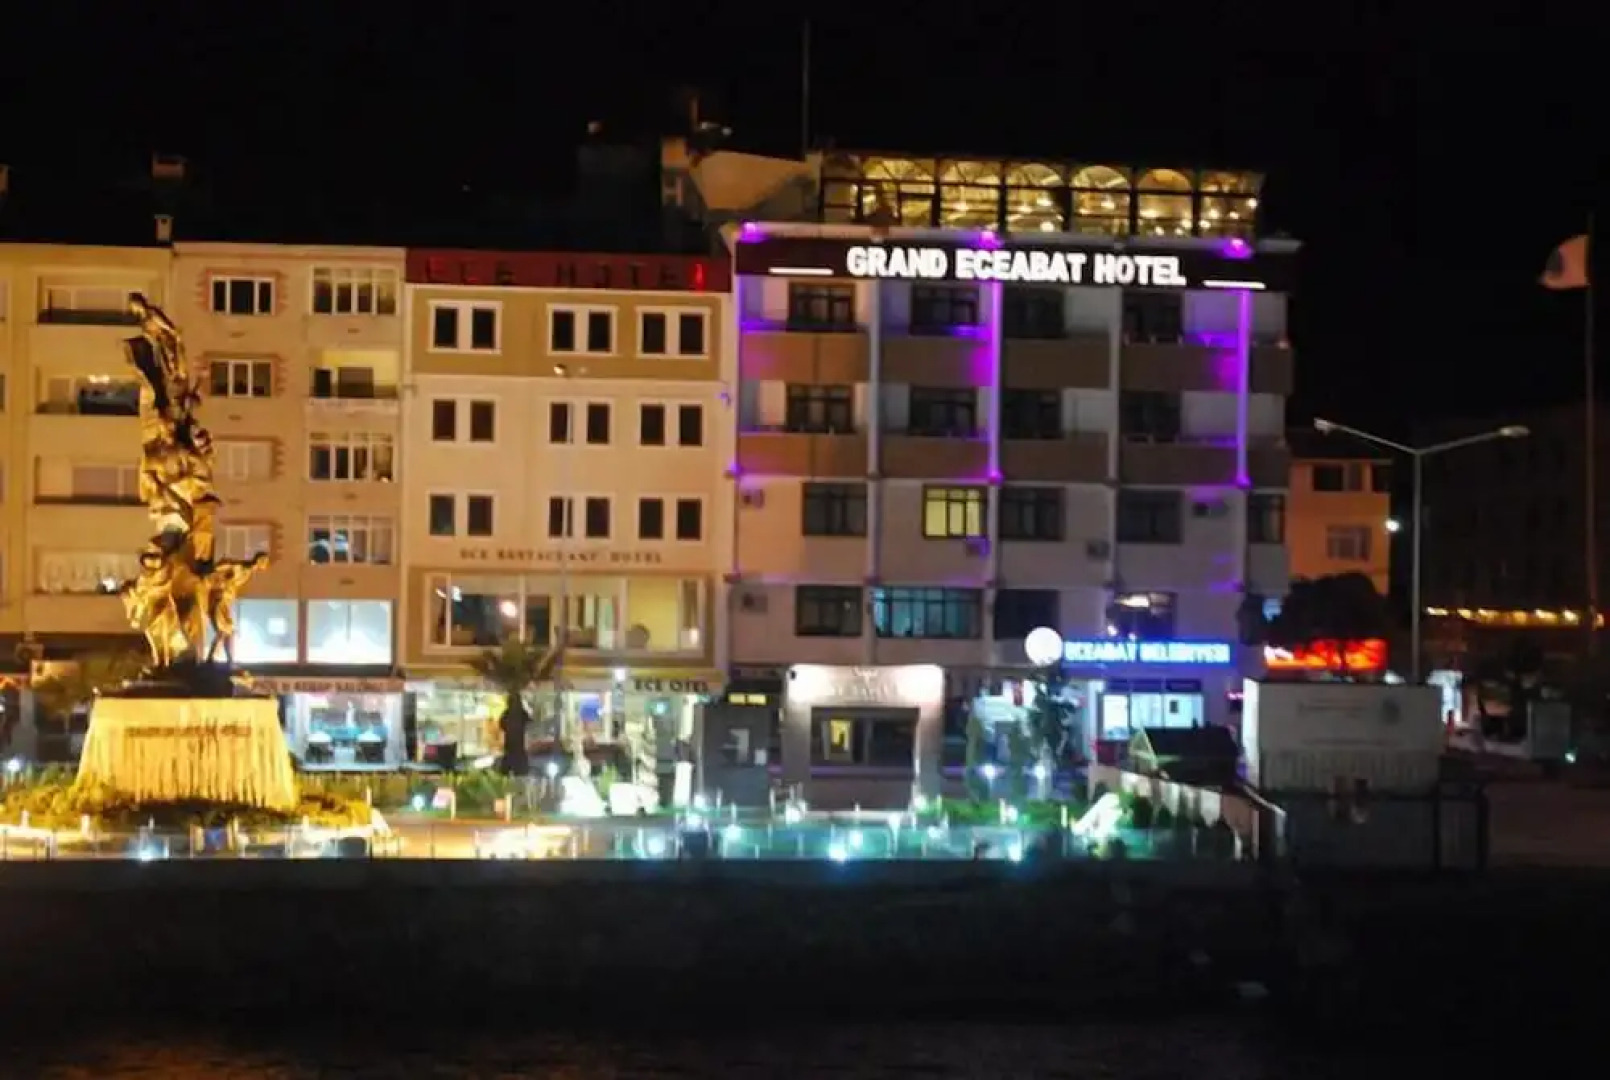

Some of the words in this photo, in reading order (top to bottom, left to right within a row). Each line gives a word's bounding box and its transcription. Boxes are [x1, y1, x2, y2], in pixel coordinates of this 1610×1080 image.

[846, 247, 947, 278] GRAND
[956, 249, 1087, 283] ECEABAT
[1092, 254, 1187, 287] HOTEL
[634, 678, 662, 691] ECE
